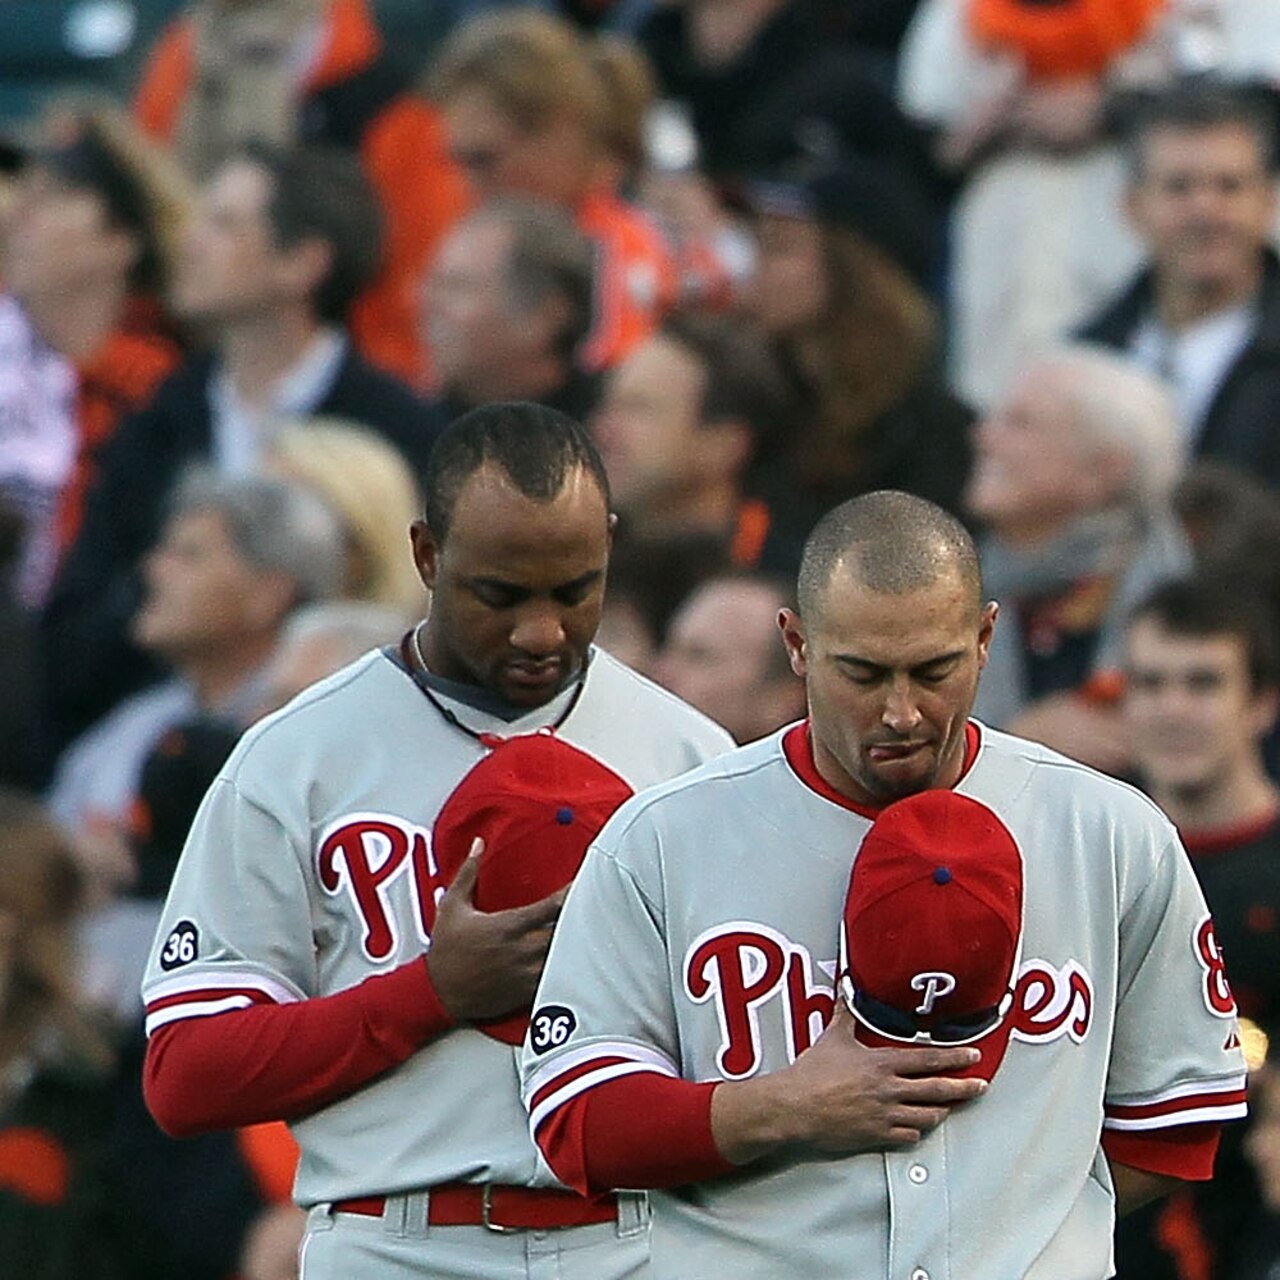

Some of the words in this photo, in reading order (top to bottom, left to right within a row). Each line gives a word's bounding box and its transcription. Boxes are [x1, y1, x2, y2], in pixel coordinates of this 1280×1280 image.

[163, 931, 195, 962] 36
[910, 972, 956, 1015] P
[534, 1015, 570, 1047] 36
